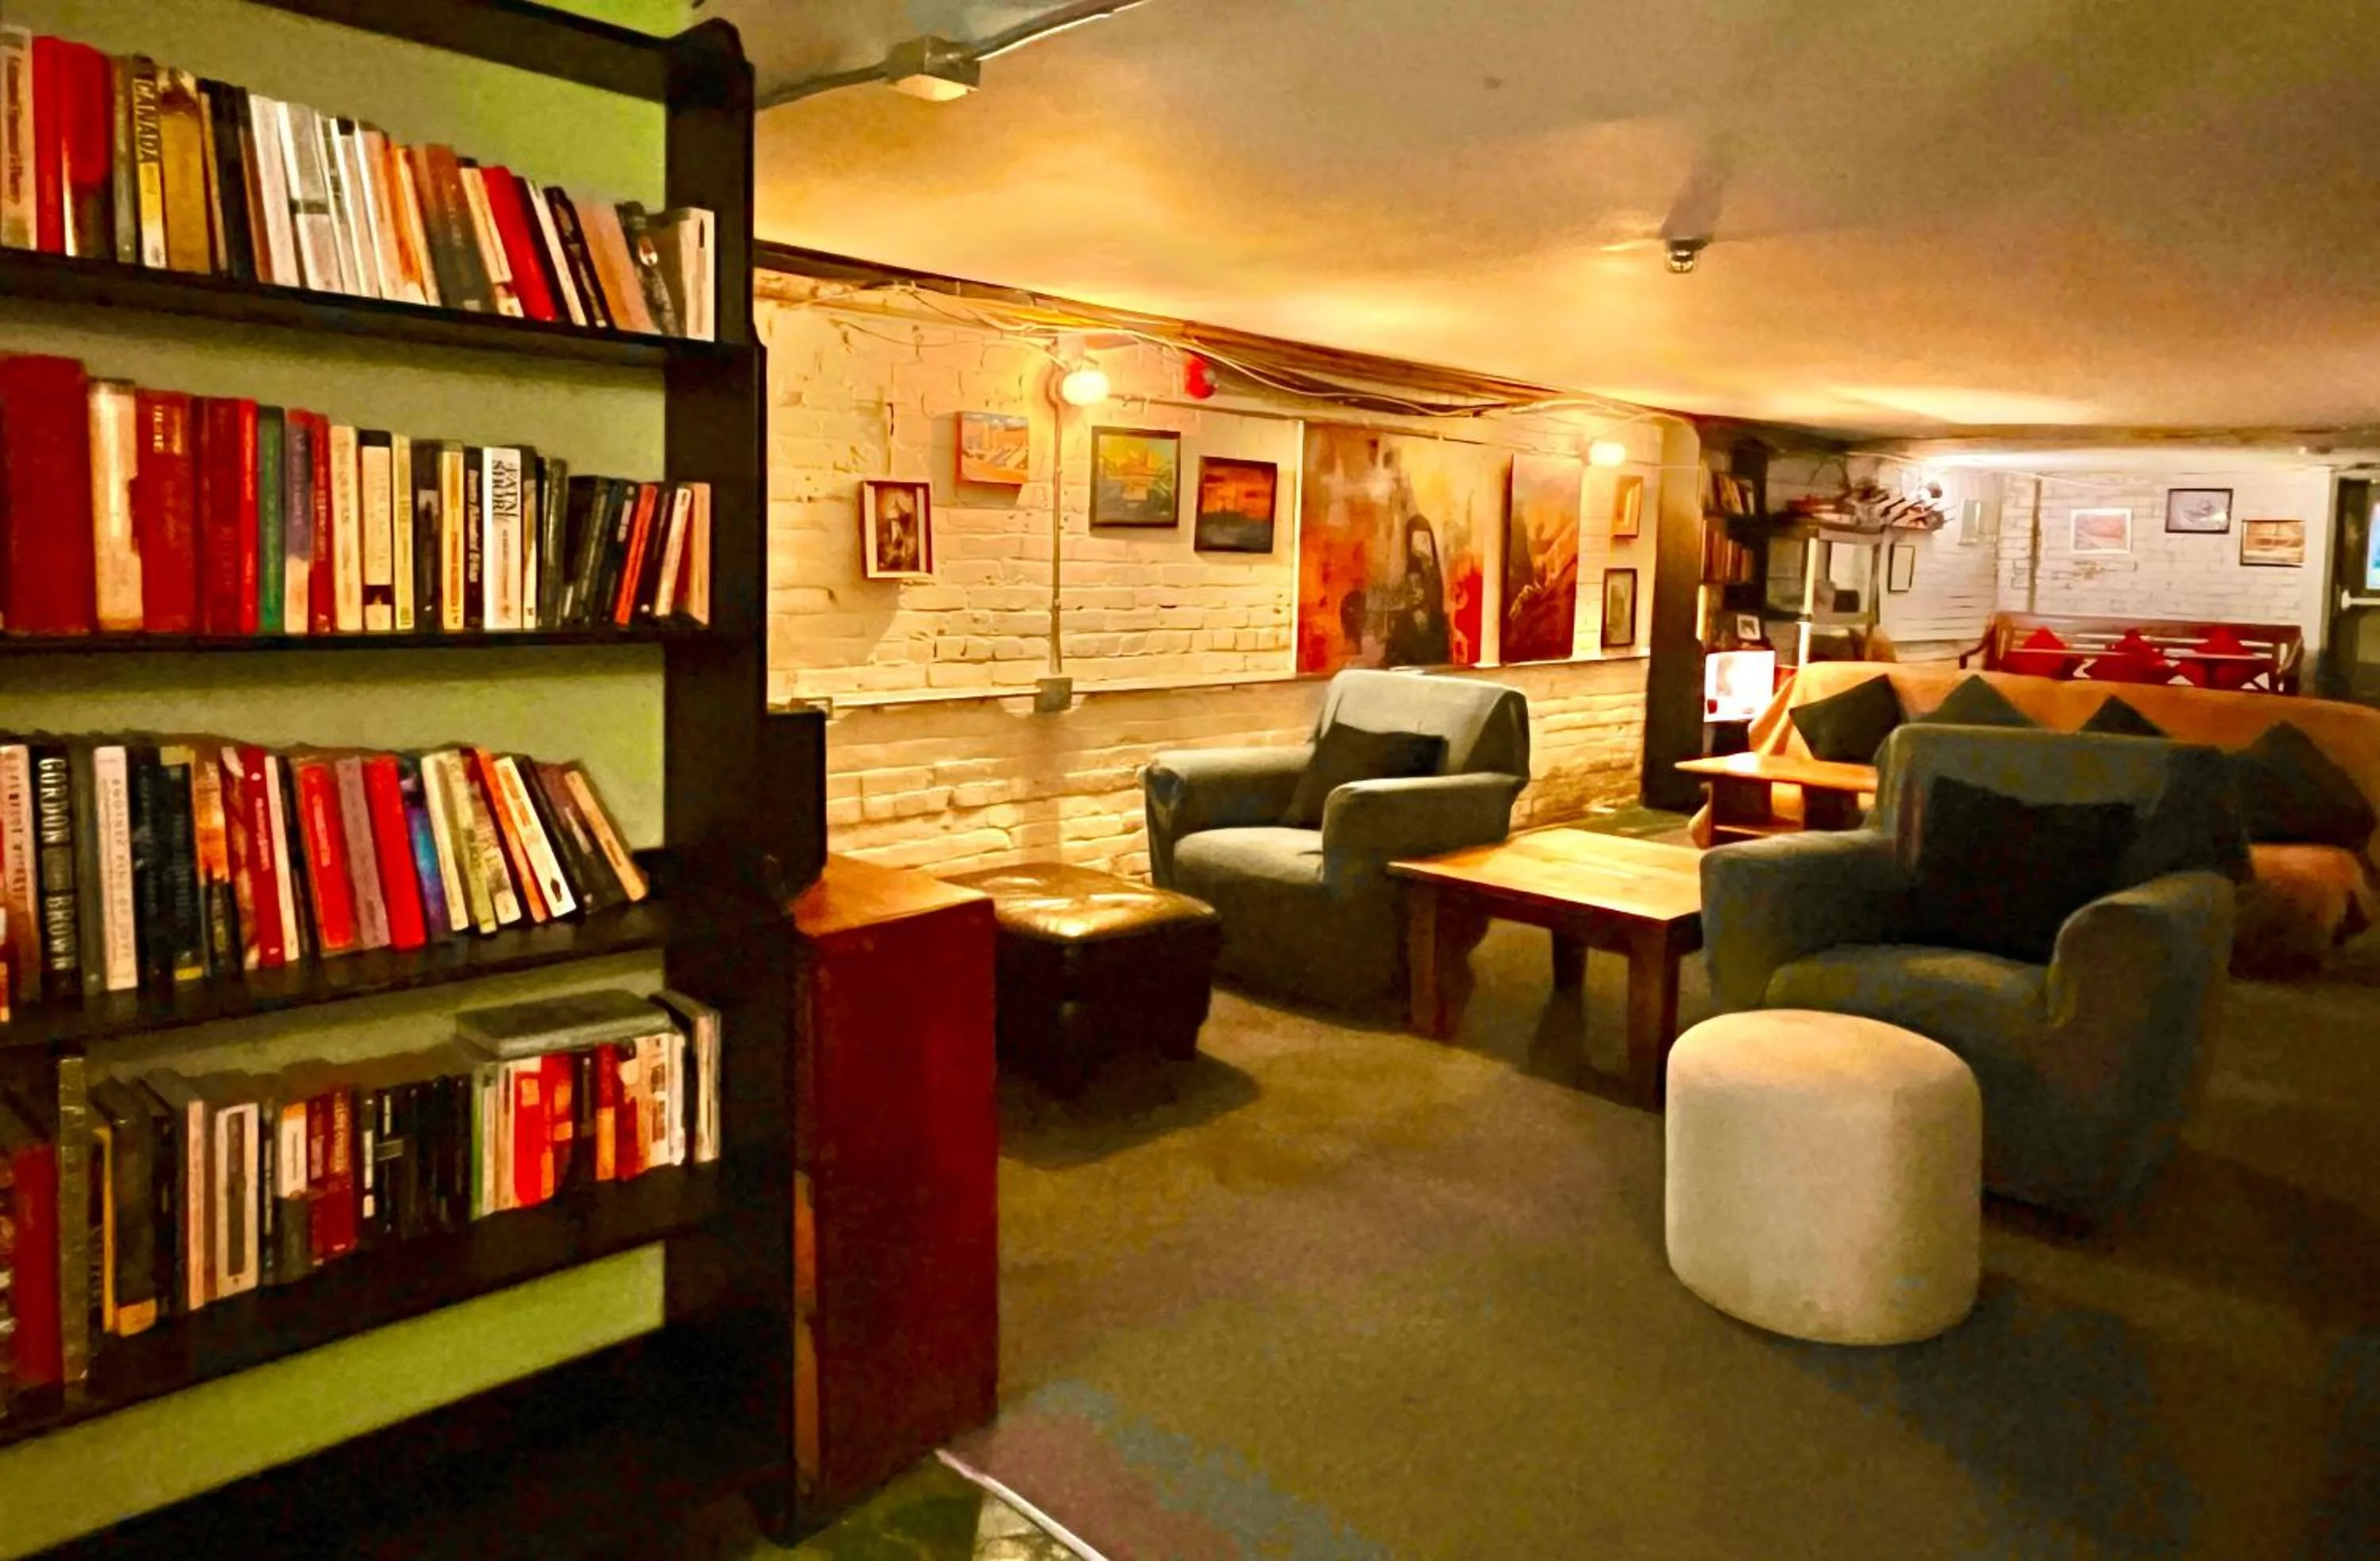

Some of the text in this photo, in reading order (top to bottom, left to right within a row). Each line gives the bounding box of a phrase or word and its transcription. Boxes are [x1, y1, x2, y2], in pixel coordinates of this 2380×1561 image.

[133, 79, 158, 160] CANADA
[38, 757, 76, 969] GORDON BROWN
